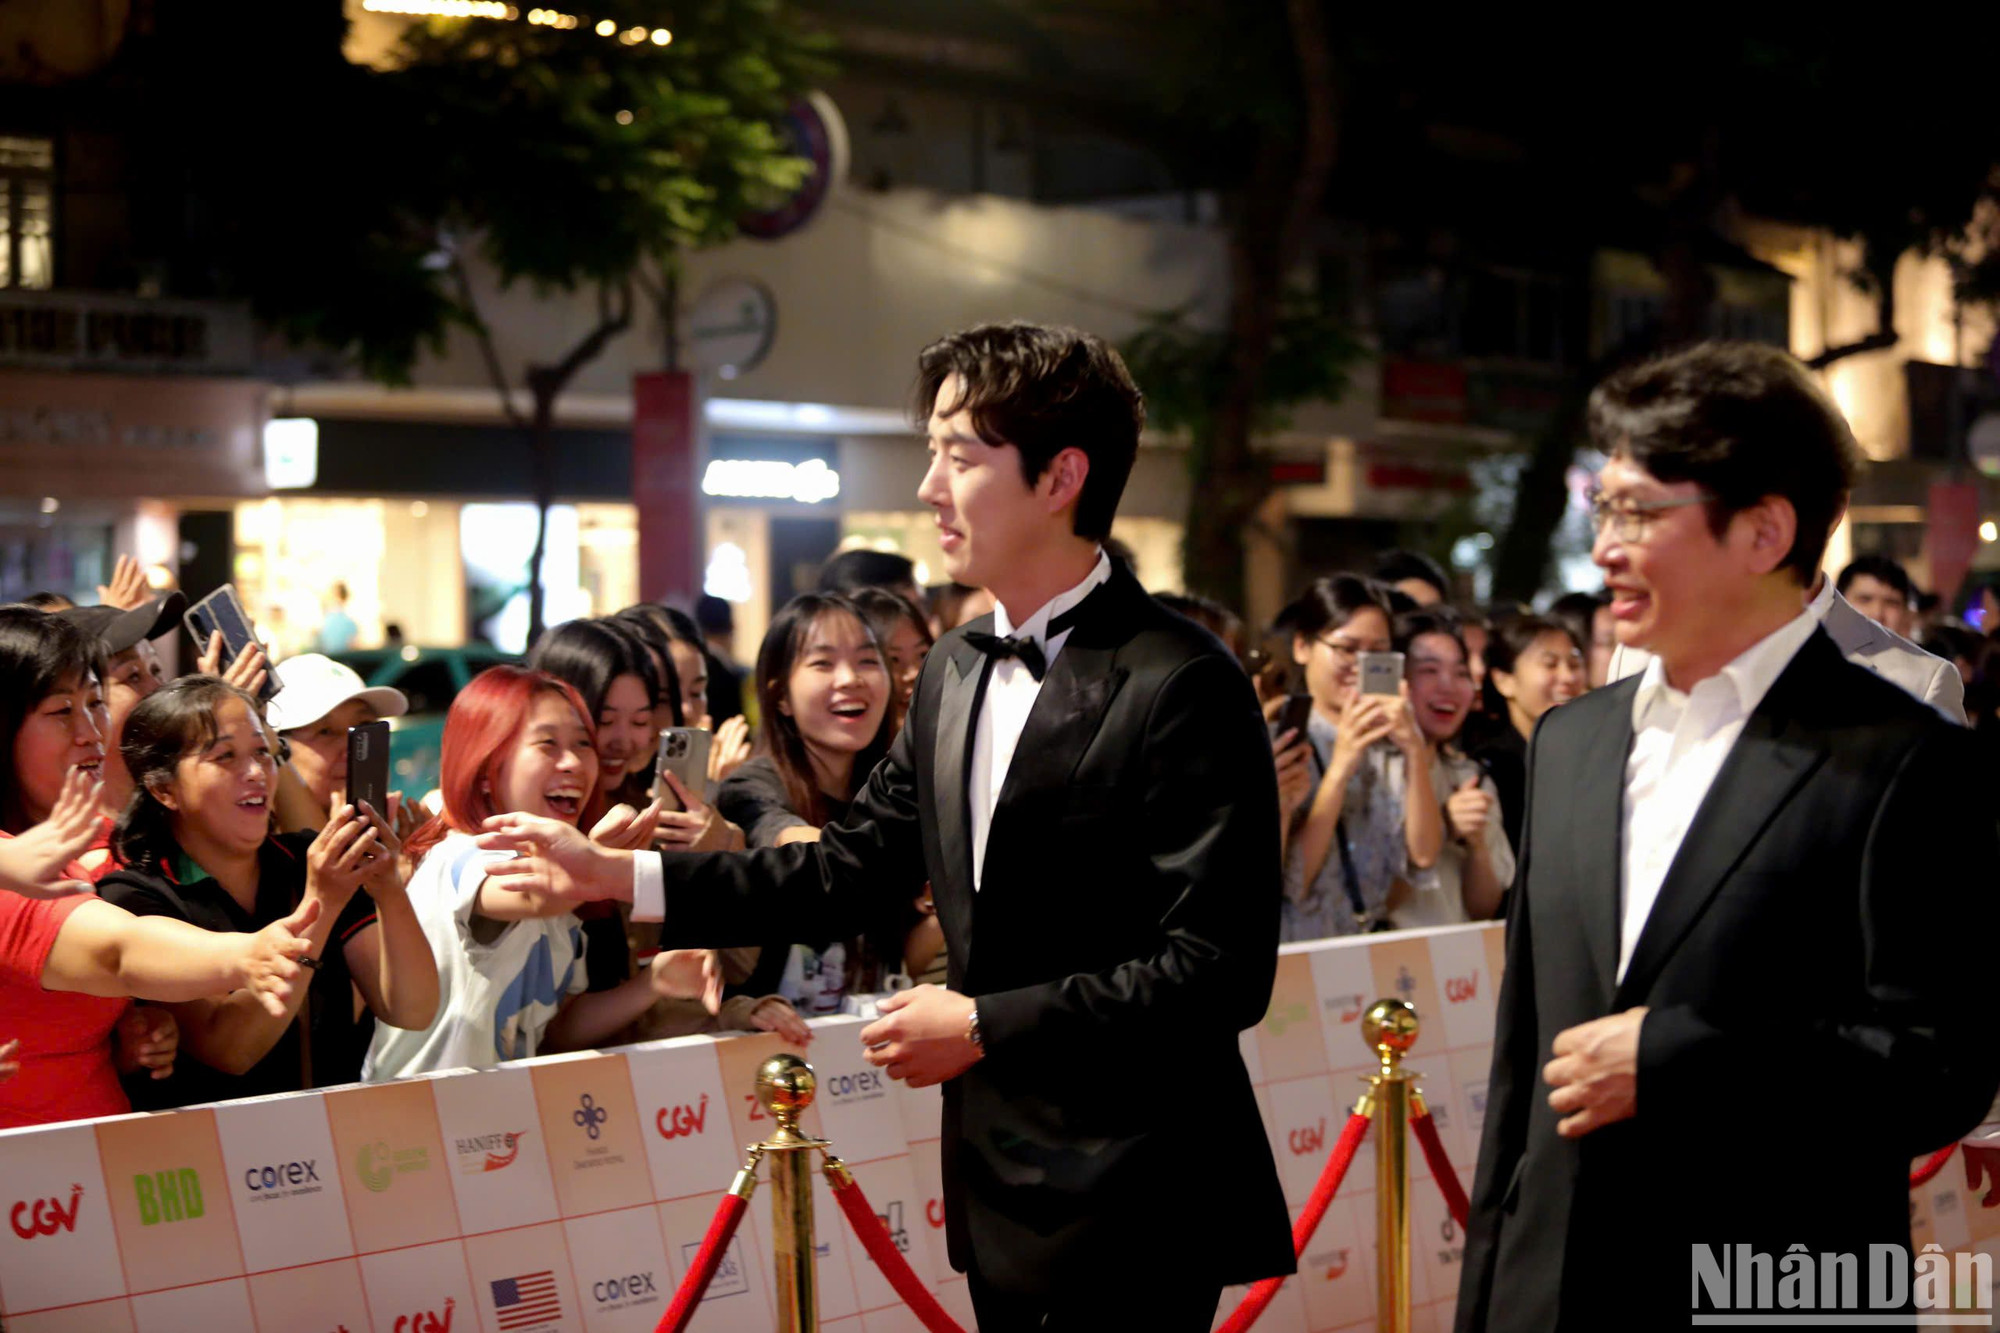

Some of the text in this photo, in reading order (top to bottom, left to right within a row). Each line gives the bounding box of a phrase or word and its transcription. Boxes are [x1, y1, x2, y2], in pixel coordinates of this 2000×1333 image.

[828, 1070, 882, 1096] corex
[656, 1093, 709, 1140] CGV
[1288, 1117, 1327, 1155] CGV
[245, 1159, 319, 1191] corex
[10, 1183, 84, 1240] CGV
[134, 1167, 205, 1226] BHD
[593, 1271, 656, 1302] corex
